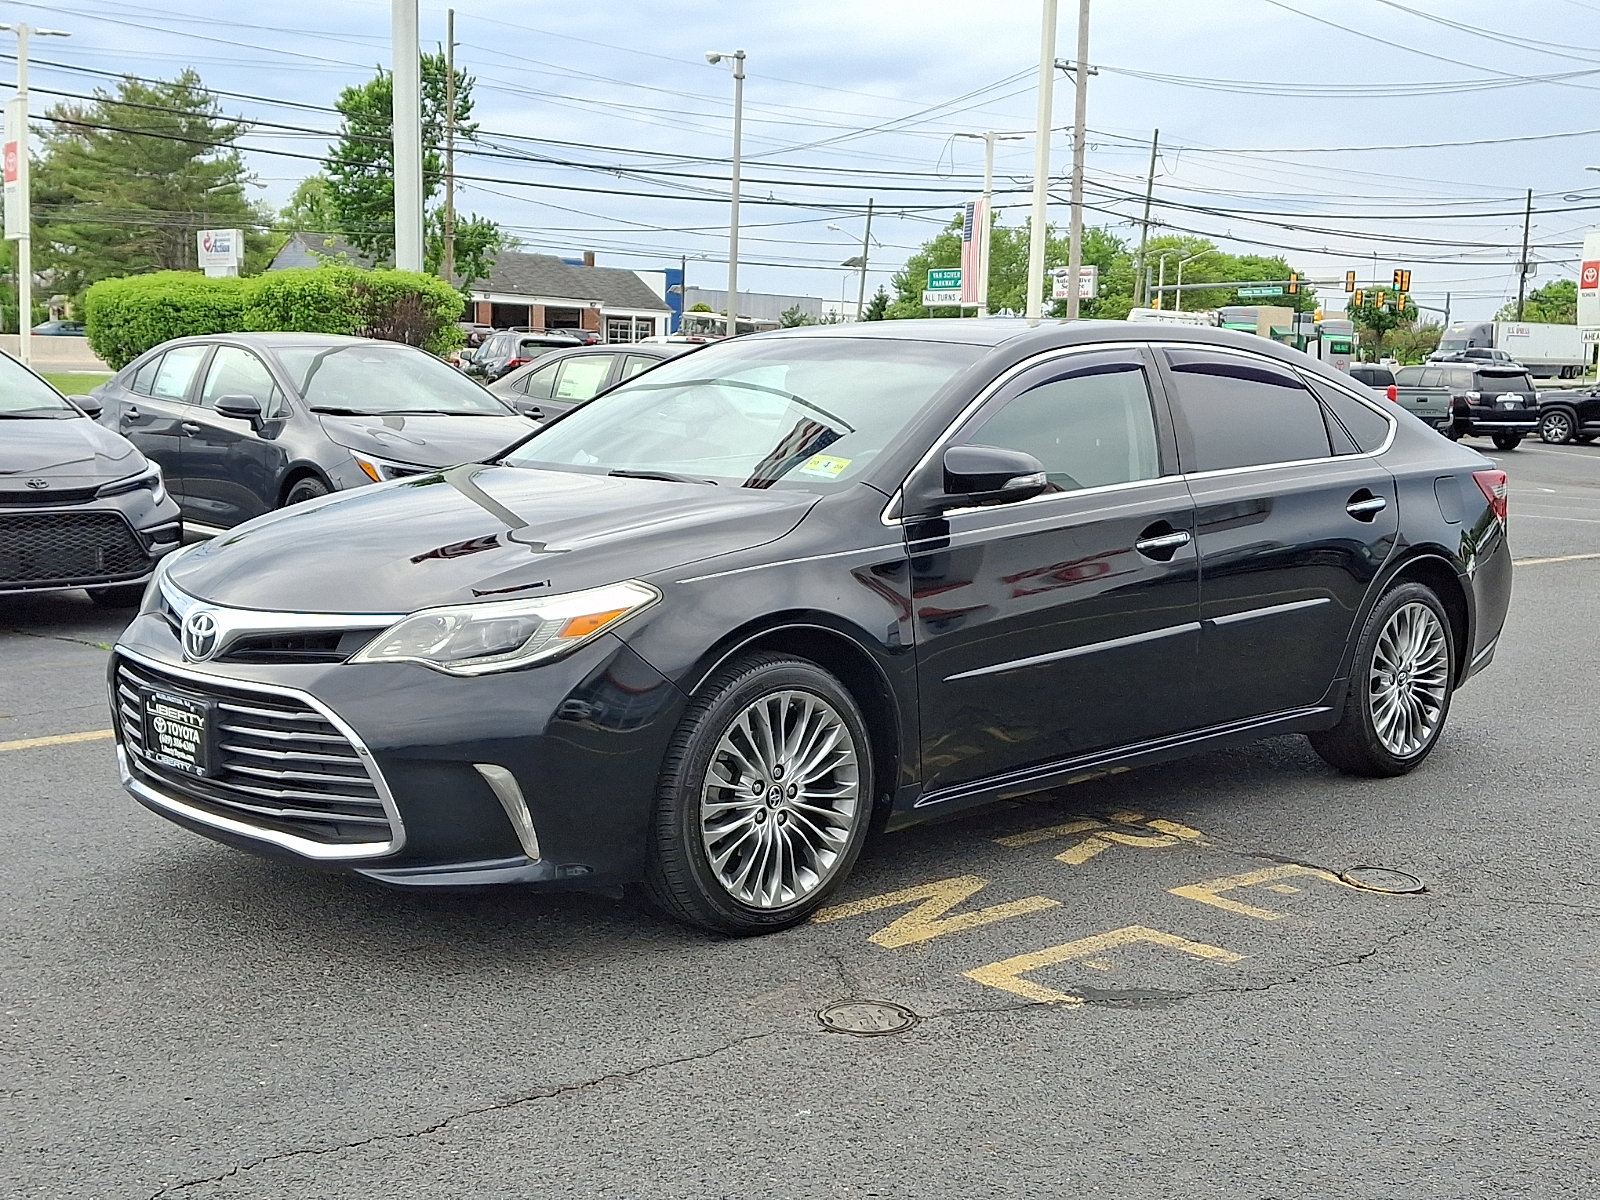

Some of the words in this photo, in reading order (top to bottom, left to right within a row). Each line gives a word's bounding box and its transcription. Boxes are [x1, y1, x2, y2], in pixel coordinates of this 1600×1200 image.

[1583, 333, 1600, 341] AHEA
[146, 700, 205, 727] LIBERTY
[166, 721, 201, 744] TOYOTA
[155, 753, 192, 771] LIBERTY
